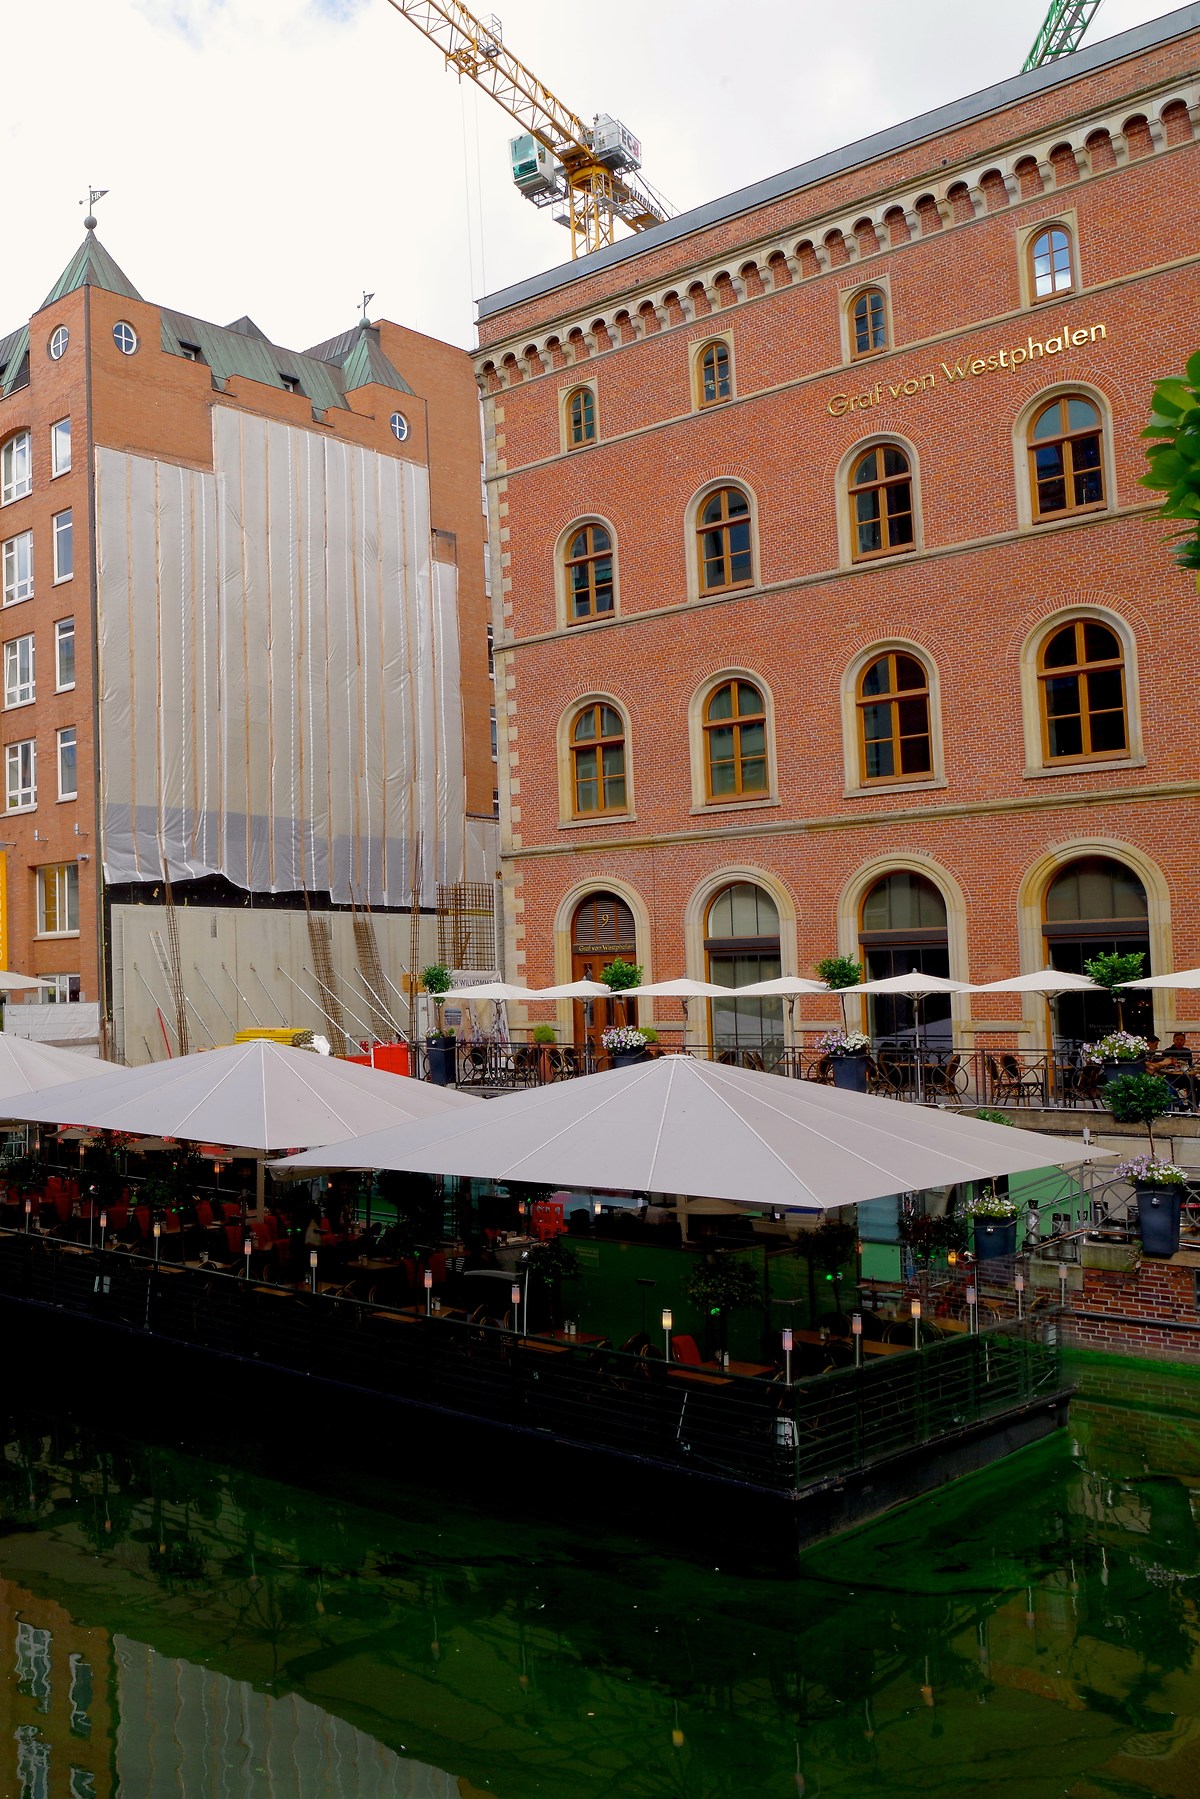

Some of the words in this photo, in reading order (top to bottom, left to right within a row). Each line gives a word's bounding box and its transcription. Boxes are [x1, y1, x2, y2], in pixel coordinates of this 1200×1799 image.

[91, 192, 102, 201] HR
[826, 381, 883, 417] Graf
[887, 373, 936, 399] von
[940, 324, 1108, 383] Westphalen
[602, 914, 609, 927] 9
